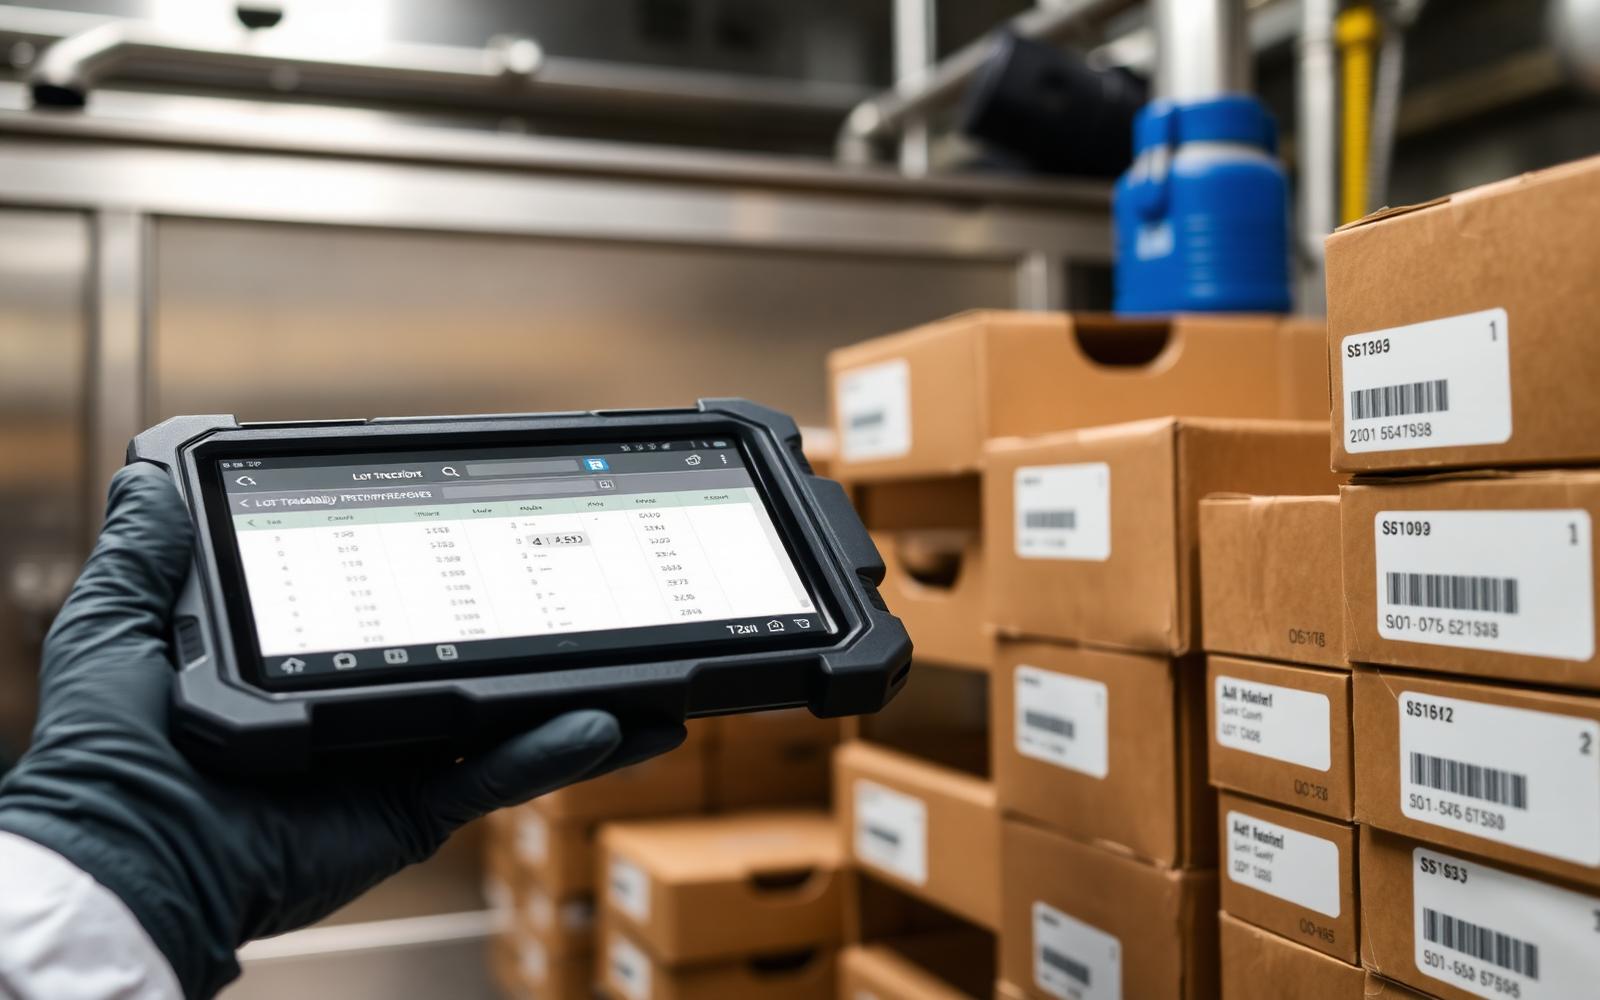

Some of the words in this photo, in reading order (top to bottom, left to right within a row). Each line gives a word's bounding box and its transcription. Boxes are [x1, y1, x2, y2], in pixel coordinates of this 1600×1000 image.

[1489, 320, 1497, 342] 1
[1568, 522, 1578, 545] 1
[1578, 731, 1593, 754] 2
